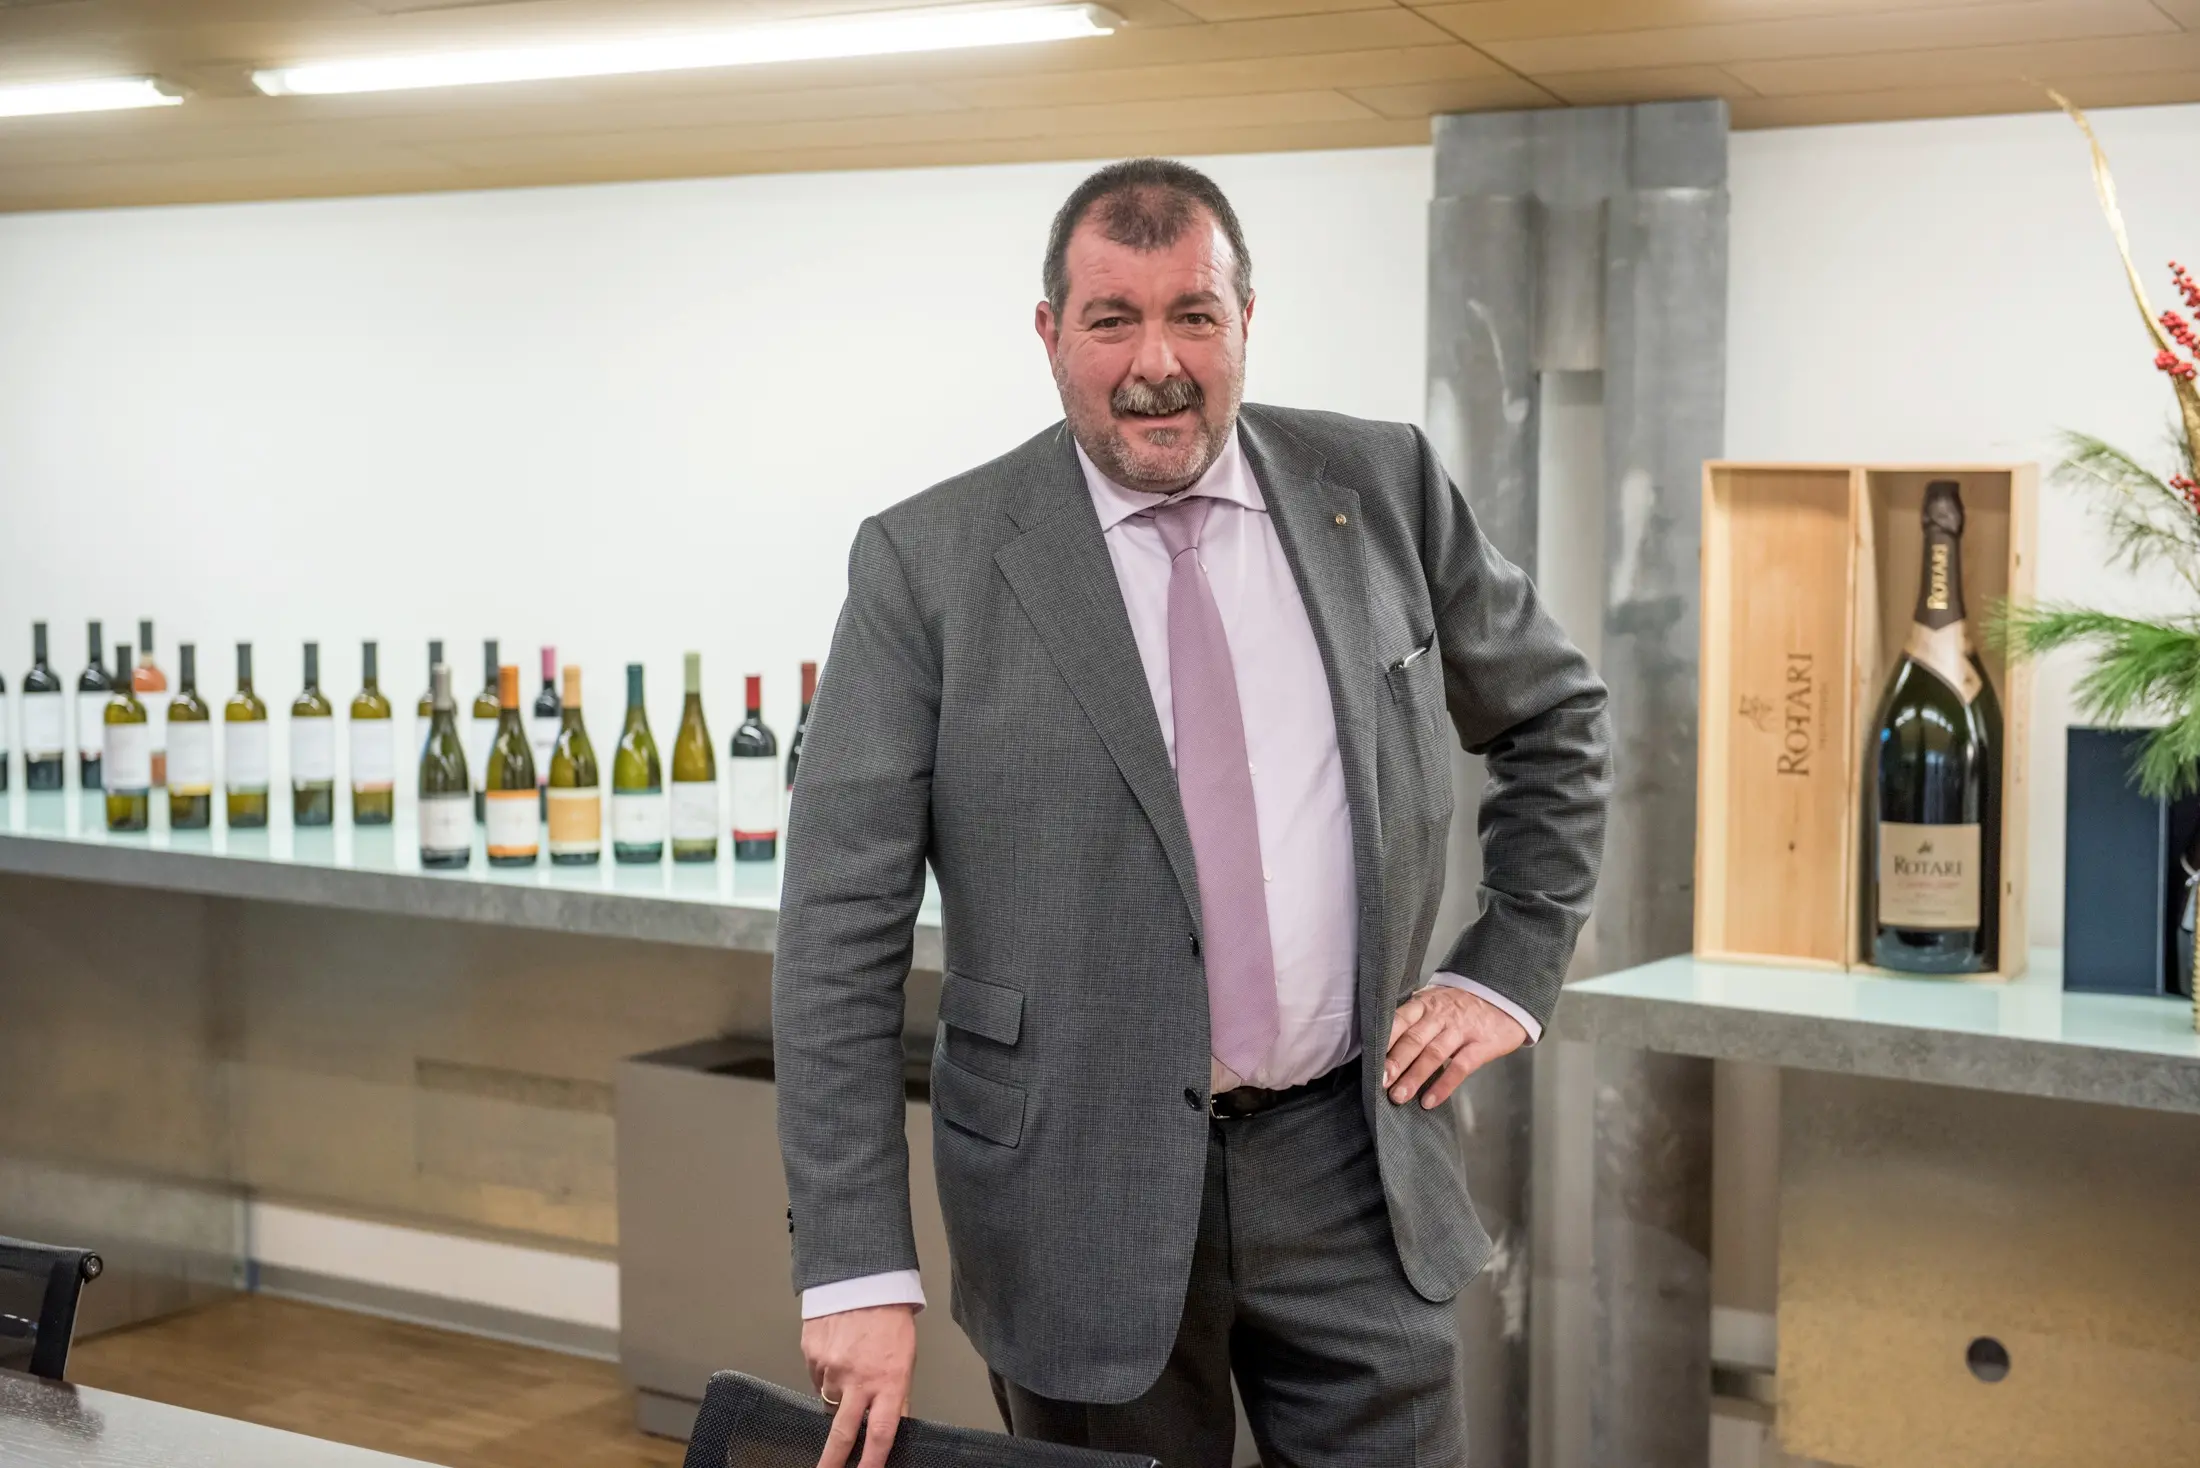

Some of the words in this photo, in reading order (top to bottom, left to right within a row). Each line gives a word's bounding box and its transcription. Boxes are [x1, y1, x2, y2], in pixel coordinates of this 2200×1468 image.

[1927, 543, 1948, 610] ROTARI
[1777, 652, 1813, 777] ROTARI
[1893, 855, 1963, 876] ROTARI
